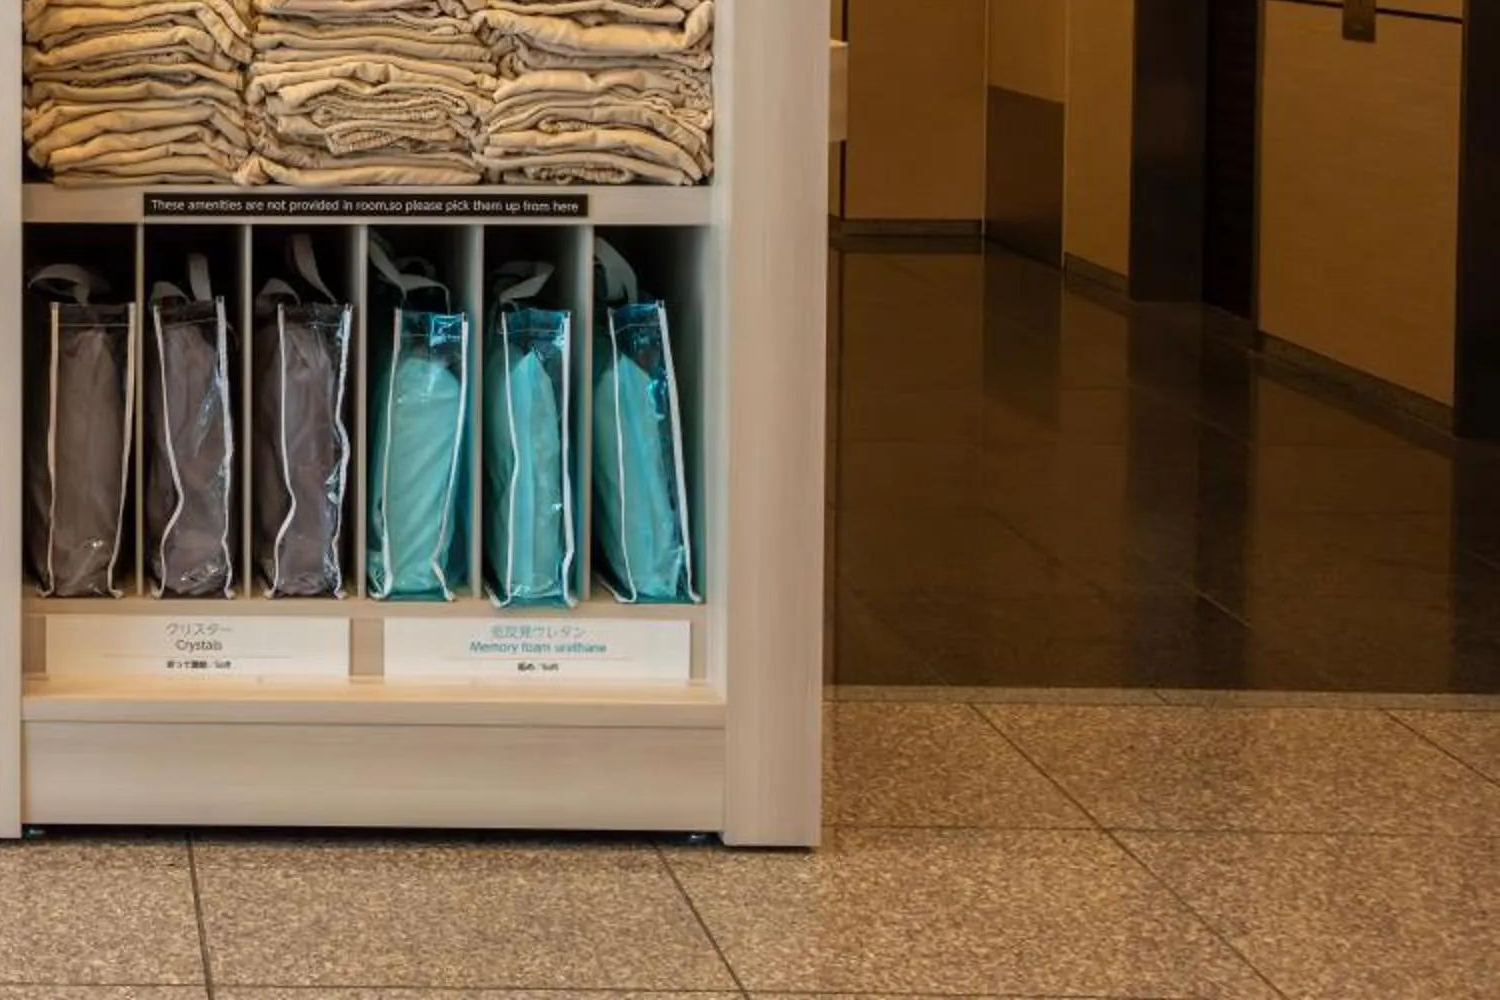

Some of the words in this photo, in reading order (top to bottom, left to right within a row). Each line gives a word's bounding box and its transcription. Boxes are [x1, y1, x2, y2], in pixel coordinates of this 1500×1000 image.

[151, 200, 184, 211] These
[187, 199, 242, 211] amenities
[246, 202, 265, 211] are
[267, 200, 286, 211] not
[289, 199, 339, 213] provided
[343, 200, 353, 211] in
[405, 200, 443, 213] please
[446, 200, 468, 213] pick
[472, 200, 501, 211] them
[506, 202, 520, 213] up
[523, 200, 550, 212] from
[553, 200, 579, 212] here
